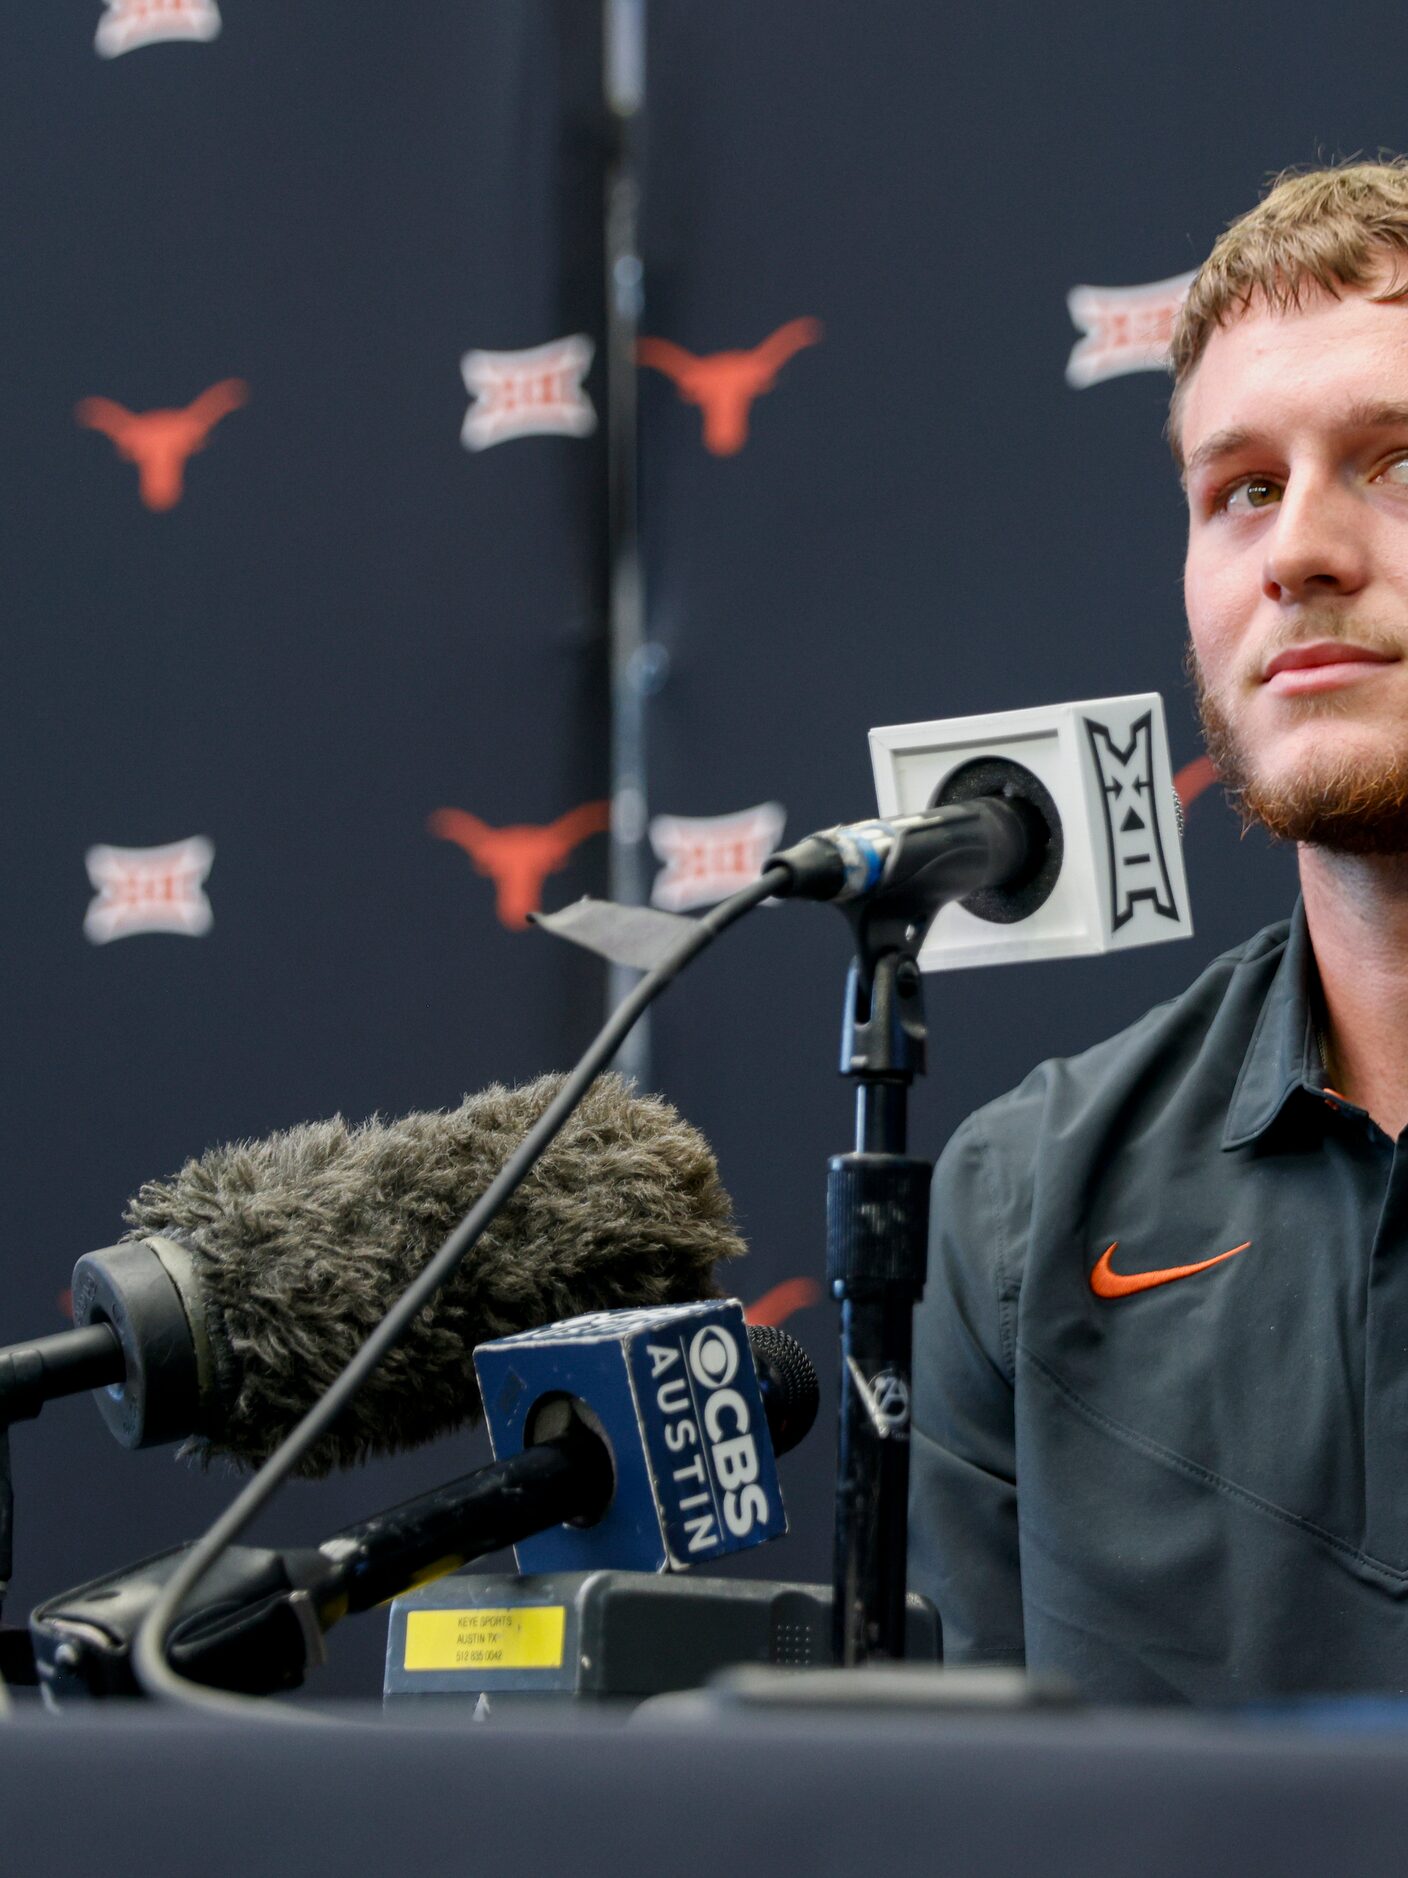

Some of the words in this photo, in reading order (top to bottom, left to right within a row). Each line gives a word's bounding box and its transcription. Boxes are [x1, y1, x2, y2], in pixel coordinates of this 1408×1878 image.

[646, 1343, 719, 1554] AUSTIN
[704, 1388, 770, 1538] CBS
[458, 1616, 479, 1628] KEYE
[480, 1615, 512, 1627] SPORTS
[457, 1633, 485, 1644] AUSTIN
[456, 1650, 469, 1662] 512
